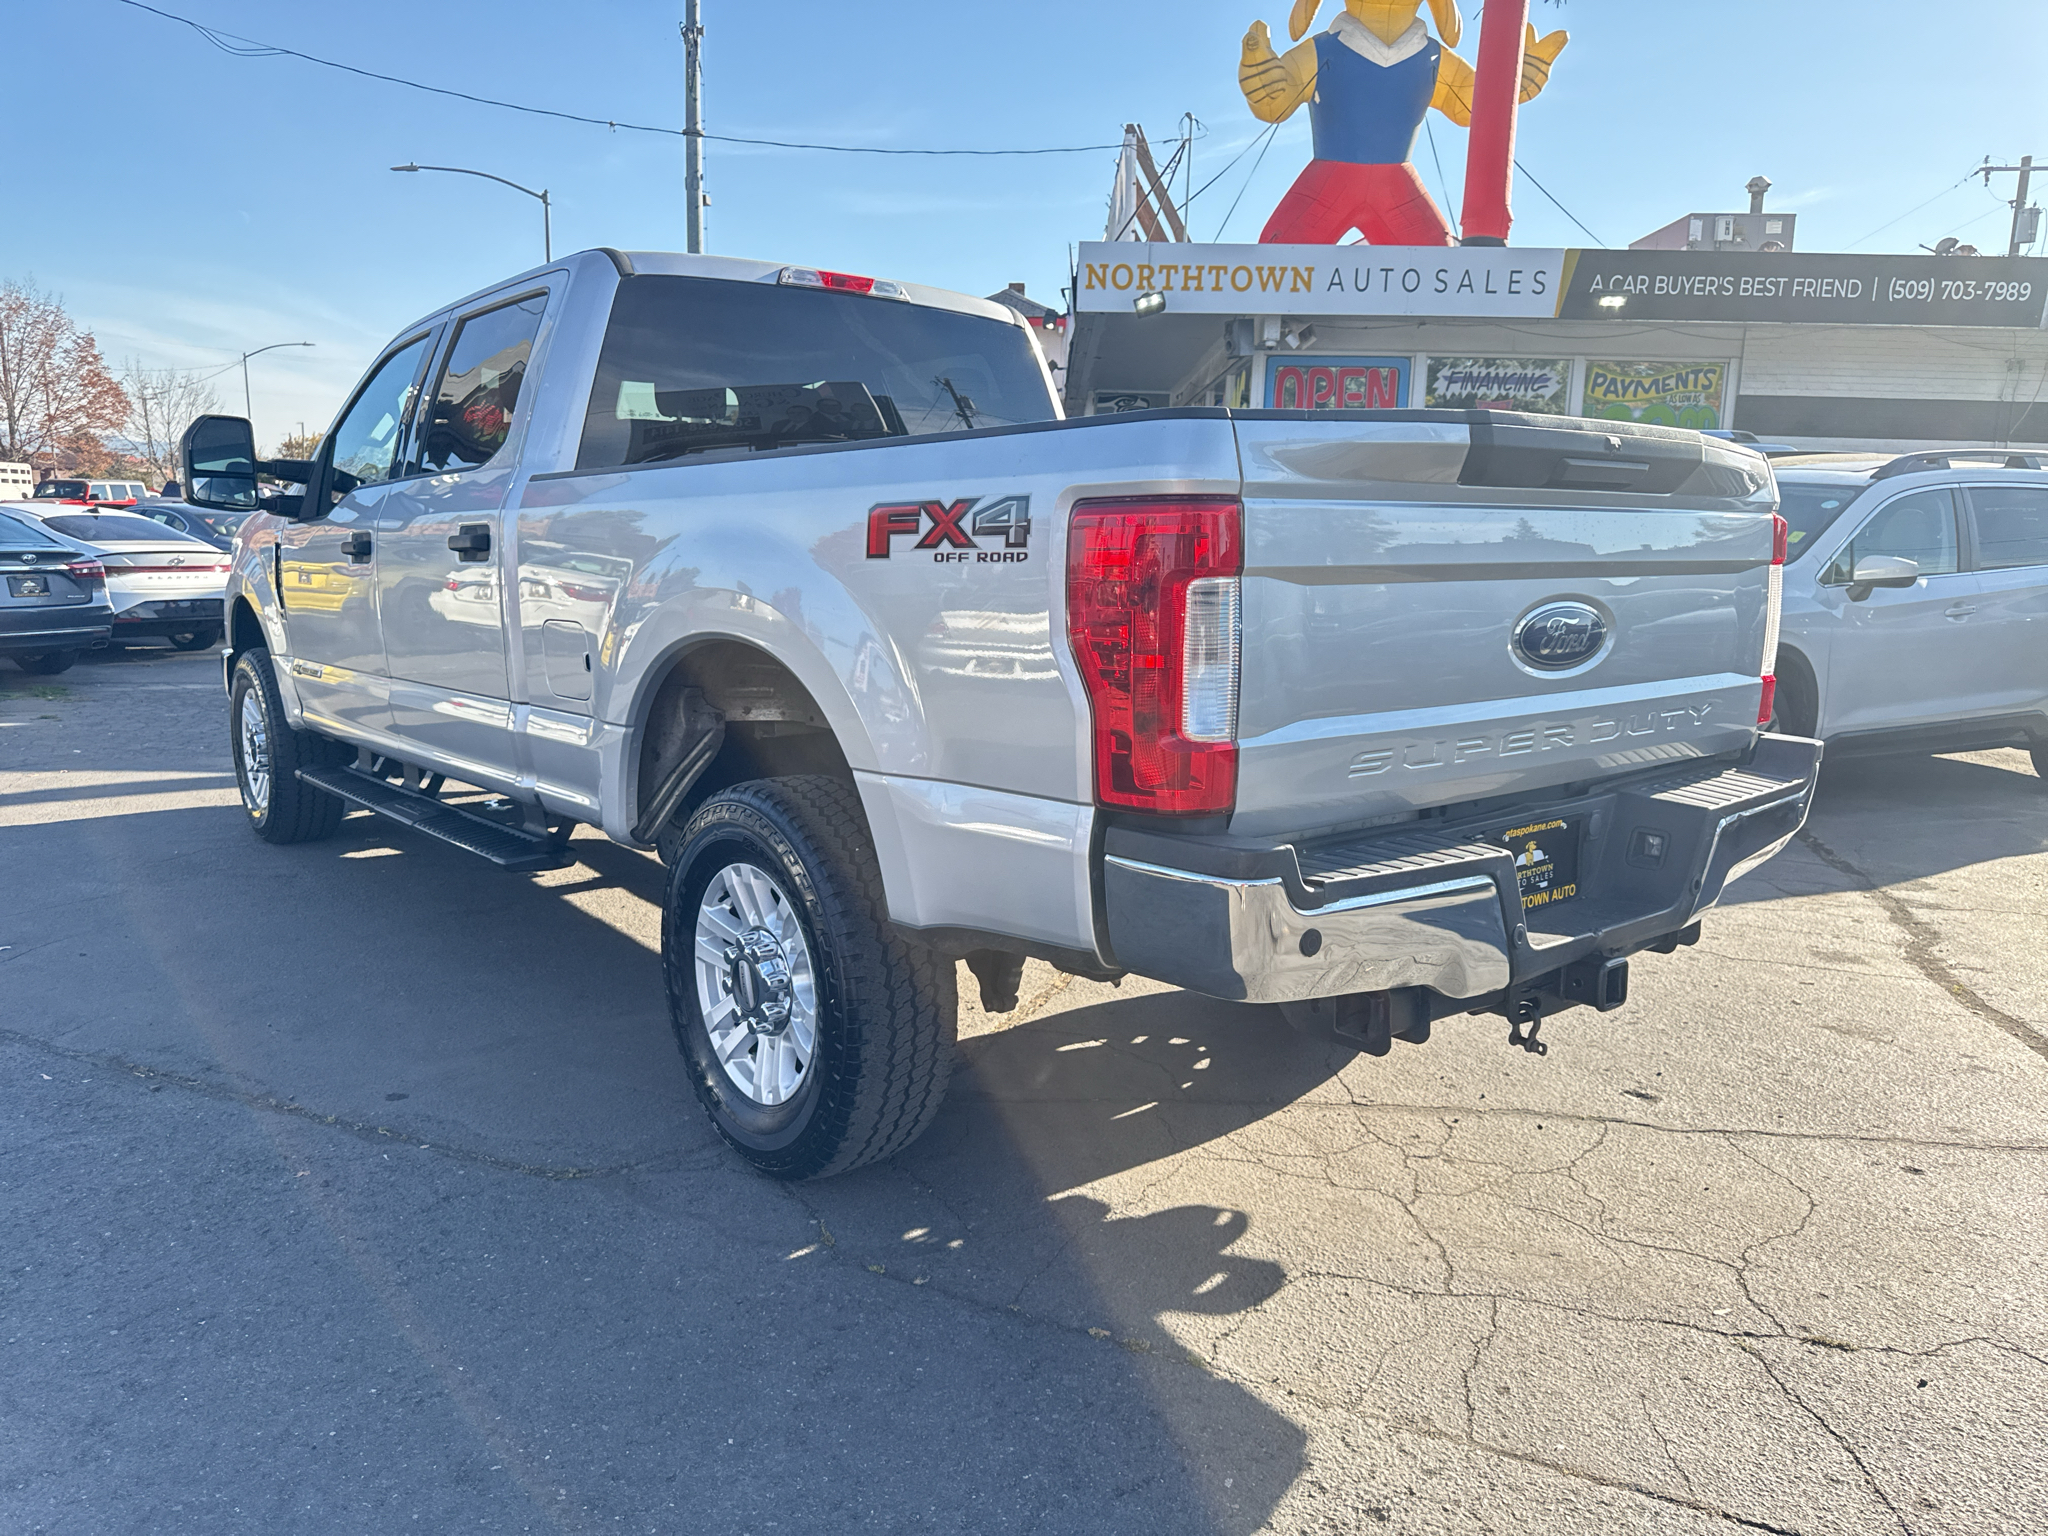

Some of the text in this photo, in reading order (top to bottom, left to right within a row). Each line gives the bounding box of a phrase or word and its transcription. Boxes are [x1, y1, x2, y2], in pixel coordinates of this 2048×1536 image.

[1085, 263, 1315, 293] NORTHTOWN
[1590, 275, 2032, 302] A CAR BUYER'S BEST FRIEND (509) 703-7989
[1275, 366, 1399, 409] OPEN
[1445, 370, 1550, 393] FINANCING
[1590, 367, 1718, 399] PAYMENTS
[1669, 394, 1702, 404] AS LOW AS
[866, 494, 1032, 559] FX4
[934, 551, 1029, 563] OFF ROAD
[1539, 616, 1590, 656] Ford
[1347, 703, 1713, 778] SUPER DUTY
[1517, 864, 1553, 879] RTHTOWN
[1530, 871, 1554, 884] SALES
[1551, 884, 1576, 902] AUTO
